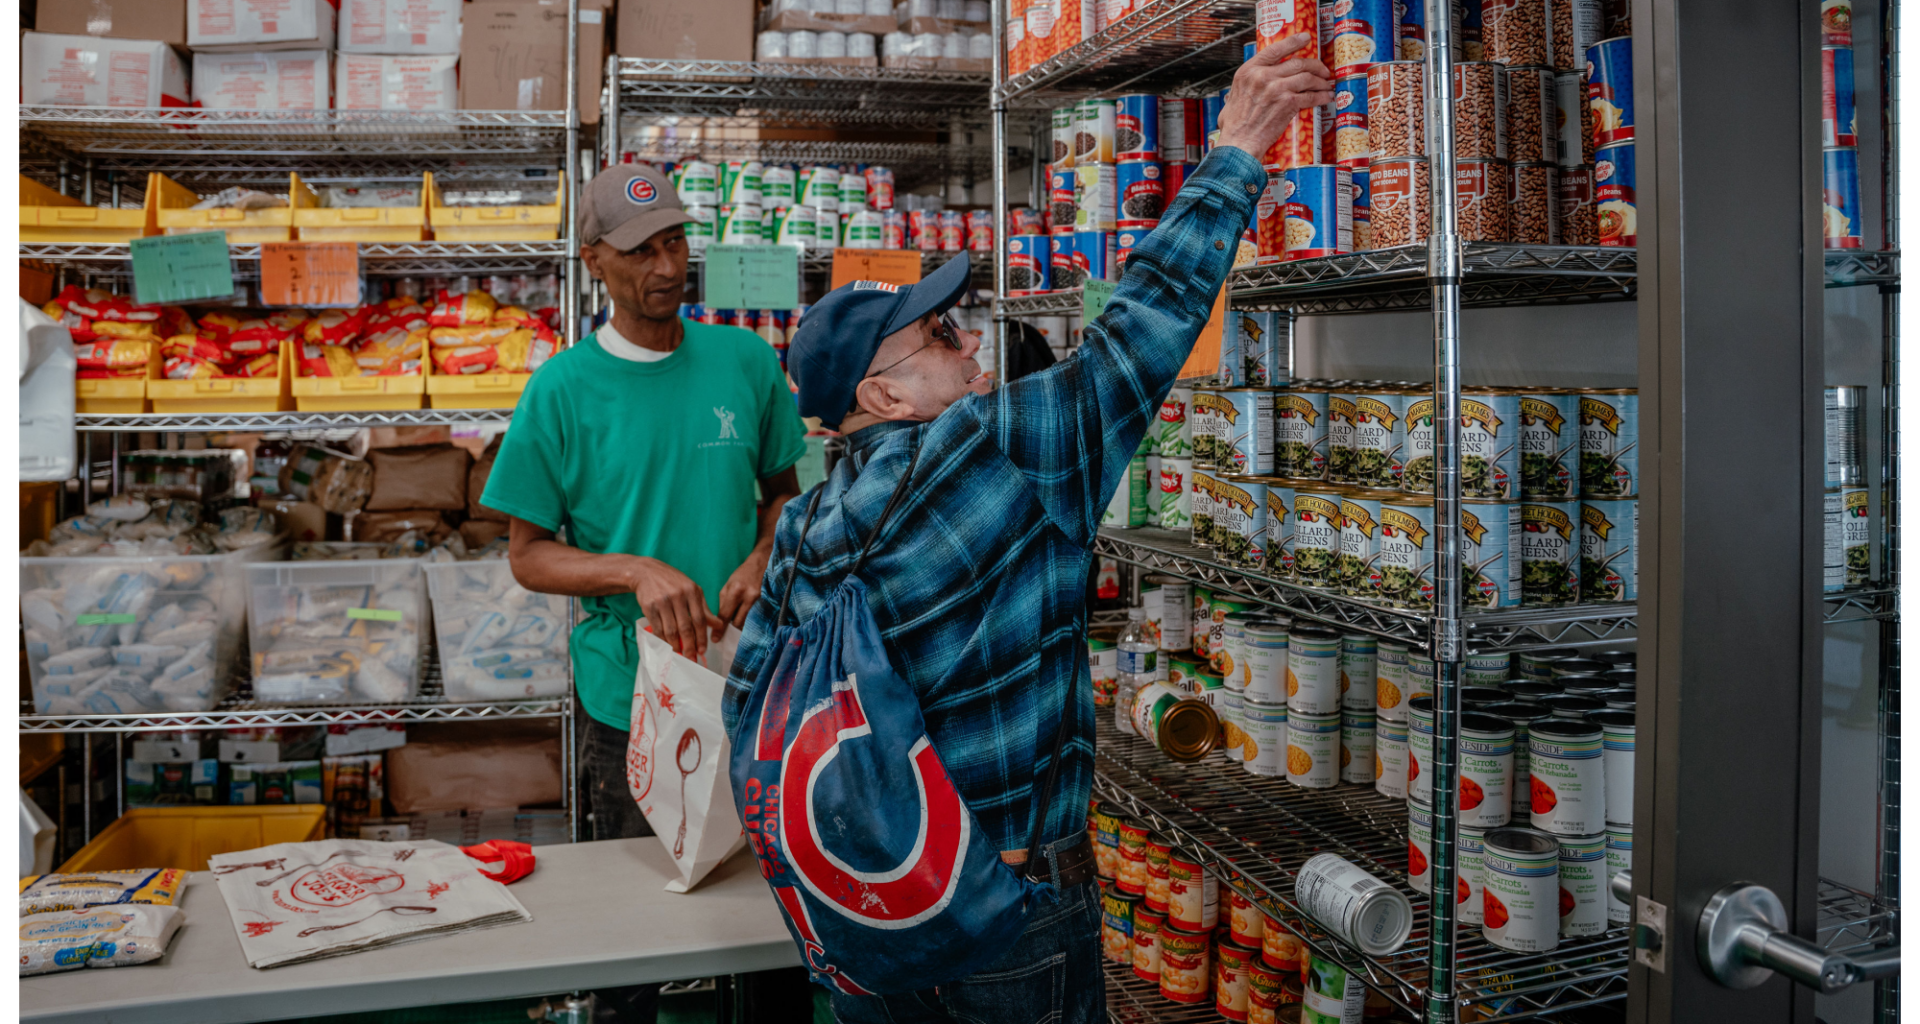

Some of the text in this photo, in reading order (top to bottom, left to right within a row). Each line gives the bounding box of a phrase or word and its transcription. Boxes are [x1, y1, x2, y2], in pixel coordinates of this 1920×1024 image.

[1261, 6, 1278, 15] BEANS
[1370, 72, 1388, 84] BEANS
[1383, 168, 1409, 178] BEANS
[1561, 176, 1588, 185] BEANS
[1130, 184, 1150, 194] Black
[1604, 188, 1622, 196] Beans
[1289, 204, 1304, 212] Beans
[1363, 401, 1387, 416] HOLMES
[1461, 402, 1490, 420] HOLMES
[1524, 401, 1554, 418] HOLMES
[1582, 401, 1612, 418] HOLMES
[1192, 425, 1215, 433] REENS
[1357, 426, 1385, 437] LARD
[1357, 437, 1380, 447] EENS
[1461, 443, 1482, 453] ENS
[1521, 441, 1546, 451] ENS
[1581, 441, 1602, 450] ENS
[1845, 495, 1865, 506] RGARET
[1296, 499, 1335, 516] GARET HOLMES
[1343, 506, 1365, 521] HOLMES
[1389, 510, 1416, 530] HOLMES
[1462, 514, 1475, 527] MES
[1537, 508, 1567, 525] HOLMES
[1295, 526, 1333, 537] OLLARD
[1843, 531, 1869, 541] GREE
[1342, 532, 1364, 544] LARD
[1521, 536, 1564, 548] LLARD
[1342, 542, 1359, 553] EENS
[1381, 541, 1413, 554] LLARD
[1381, 553, 1408, 564] EENS
[1468, 659, 1506, 668] LAKESIDE
[1480, 672, 1500, 680] Kernel
[1260, 722, 1277, 731] Corn
[1293, 731, 1331, 742] Kernel Corn
[1460, 741, 1494, 752] KESIDE
[626, 748, 648, 773] ADER
[1464, 756, 1498, 768] Carrots
[1538, 758, 1569, 771] Carrots
[1473, 766, 1504, 774] Rebanadas
[1545, 769, 1578, 779] Rebanadas
[743, 777, 775, 880] CUBS
[763, 784, 785, 874] CHICAGO
[1413, 825, 1431, 837] Carro
[1559, 846, 1582, 858] SIDE
[1458, 853, 1483, 865] arrots
[1491, 871, 1522, 888] Carrots
[1562, 872, 1595, 881] Rebanadas
[302, 879, 341, 902] JOE'S
[318, 871, 366, 899] TRADER
[1497, 883, 1531, 896] Rebanadas
[1105, 895, 1129, 916] SSION
[28, 920, 113, 936] LONG GRAIN RICE
[1172, 937, 1201, 950] Choice
[1255, 973, 1282, 989] Choic
